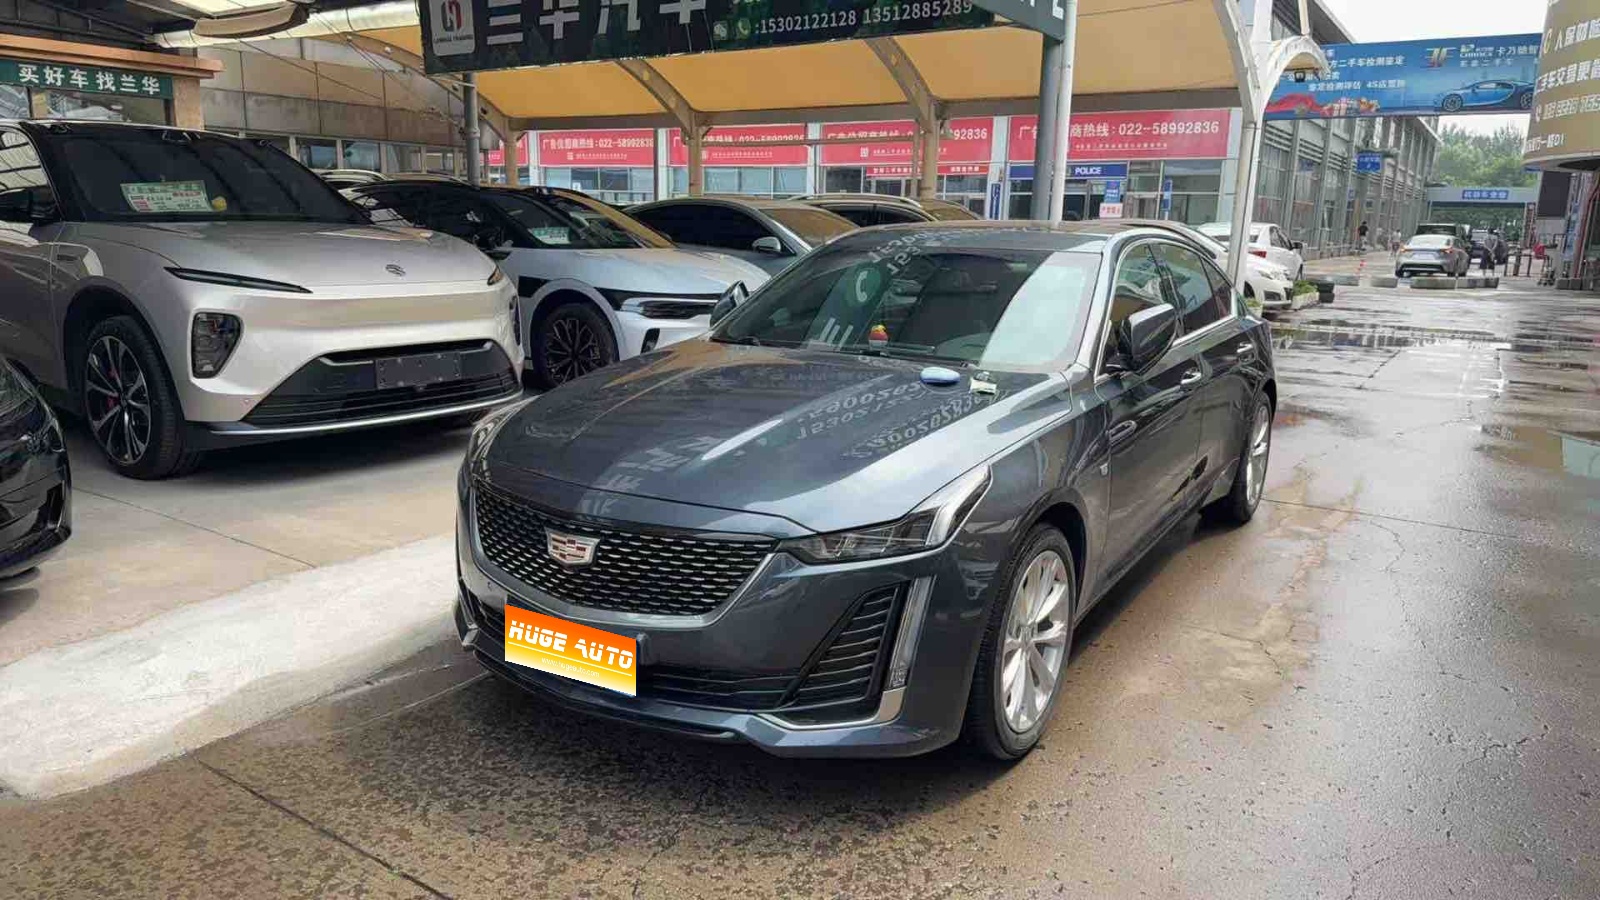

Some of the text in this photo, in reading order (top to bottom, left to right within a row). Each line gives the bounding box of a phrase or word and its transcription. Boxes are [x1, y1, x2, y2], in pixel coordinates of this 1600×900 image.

[862, 0, 973, 24] 13512885289
[18, 64, 161, 95] 买好车找兰华
[1019, 120, 1220, 141] 广商热线:022-58992836
[1074, 167, 1102, 175] POLICE
